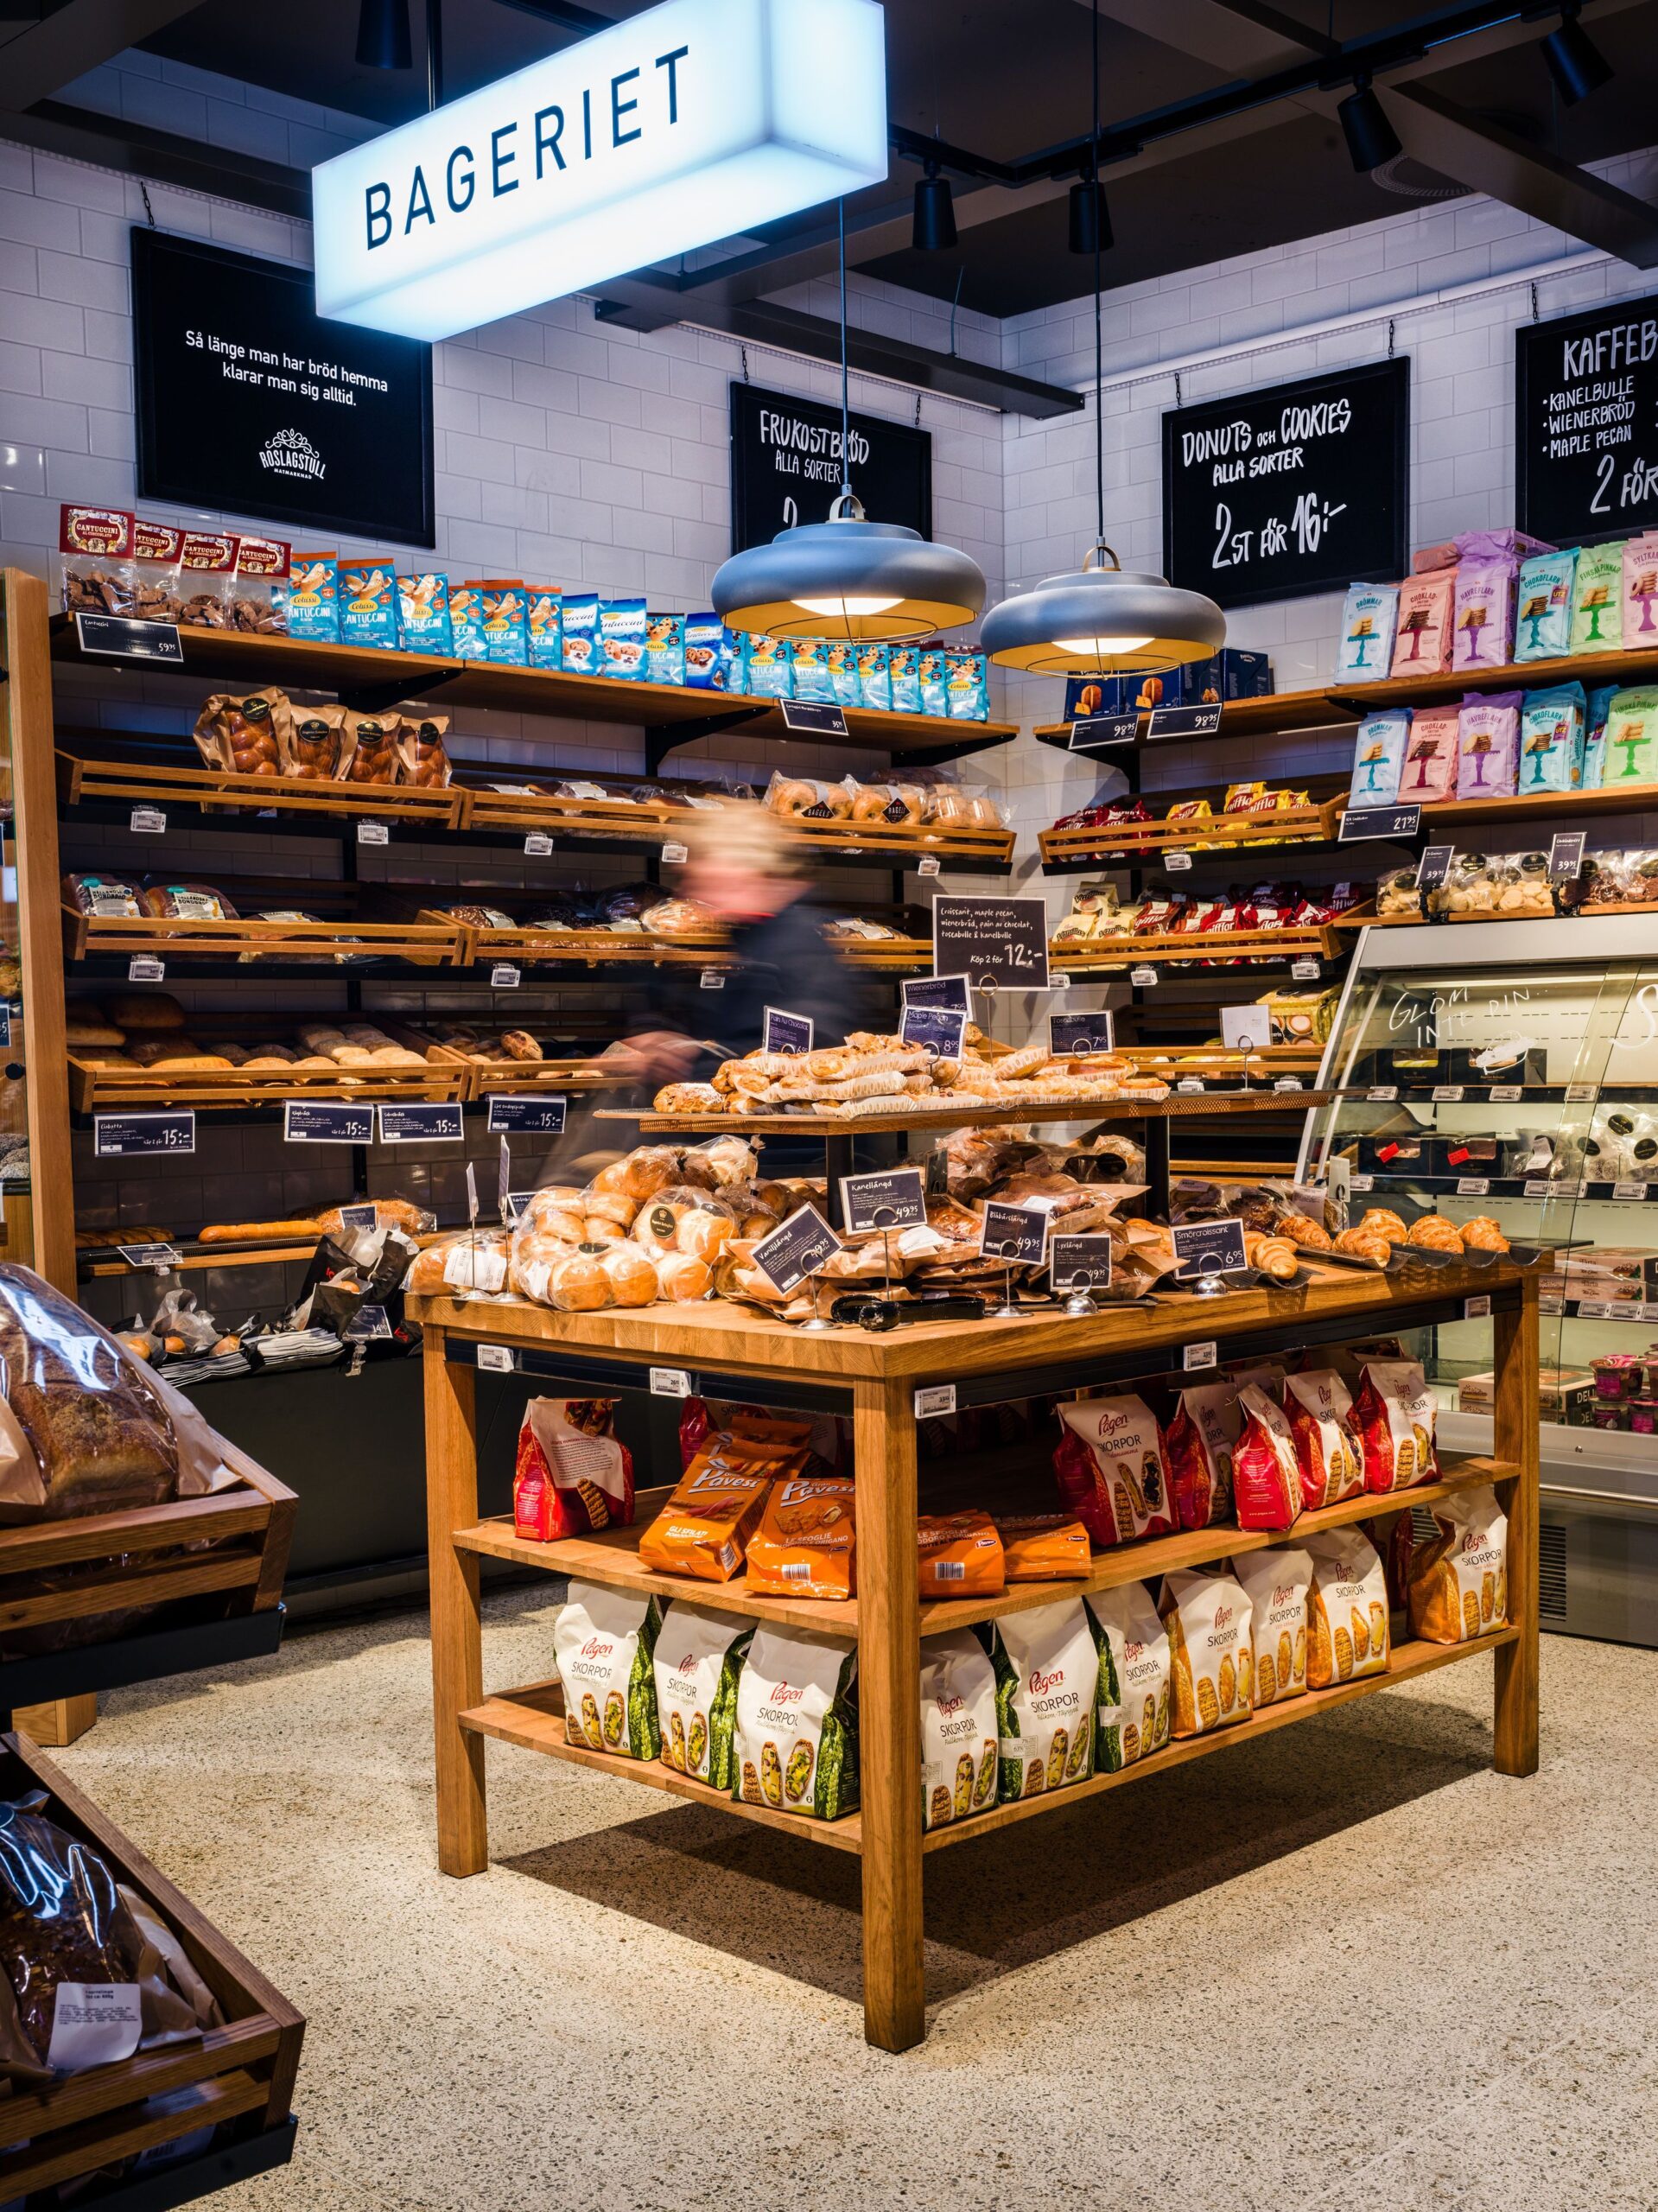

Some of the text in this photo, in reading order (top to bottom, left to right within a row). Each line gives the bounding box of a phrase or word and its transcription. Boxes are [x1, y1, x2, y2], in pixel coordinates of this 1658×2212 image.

[365, 44, 689, 251] BAGERIET
[186, 330, 388, 392] Så länge man har bröd hemma
[223, 361, 357, 407] klarar man sig alltid.
[1550, 376, 1634, 411] KANELBULLE
[1549, 396, 1635, 434] WIENERBRÖD
[1183, 398, 1351, 467] DONUTS OCH COOKIES
[1550, 424, 1631, 459] MAPLE PECAN
[259, 450, 326, 480] ROSLAGSTULL
[274, 467, 312, 480] MATMARKNAD
[776, 449, 841, 484] ALLA SORTER
[1213, 448, 1304, 486] ALLA SORTER
[1591, 454, 1658, 513] 2 FÖR
[77, 524, 118, 534] CANTUCCINI
[1261, 518, 1286, 557] FÖR
[185, 545, 223, 555] CANTUCCINI
[1524, 573, 1560, 588] CHOKOFLARN
[808, 809, 829, 818] BAGELS
[941, 907, 1016, 918] Croissant, maple pecan,
[1135, 915, 1167, 928] gifflar
[980, 920, 994, 929] pain
[1004, 921, 1032, 930] chocolat,
[970, 955, 984, 965] Köp
[992, 955, 1003, 963] för
[907, 982, 945, 991] Wienerbröd
[1389, 987, 1468, 1031] GLÖM
[788, 1019, 809, 1031] Chocolat
[1418, 1011, 1474, 1048] INTE
[852, 1179, 892, 1191] Kanellängd
[1177, 1226, 1229, 1240] Smörcroissant
[1098, 1414, 1128, 1436] Pågen
[1096, 1434, 1141, 1452] SKORPOR
[692, 1469, 761, 1488] Pavesi
[1461, 1548, 1502, 1567] SKORPOR
[1335, 1562, 1354, 1583] Pågen
[1273, 1585, 1294, 1608] Pågen
[1336, 1584, 1366, 1599] SKORPOR
[1215, 1606, 1234, 1630] Pågen
[1268, 1605, 1301, 1626] SKORPOR
[581, 1637, 613, 1659] Pågen
[1207, 1628, 1239, 1648] SKORPOR
[1123, 1640, 1143, 1662] Pågen
[1125, 1660, 1161, 1681] SKORPOR
[1029, 1669, 1064, 1696] Pågen
[770, 1681, 804, 1706] Pågen
[1031, 1692, 1080, 1713] SKORPOR
[937, 1694, 964, 1719] Pågen
[940, 1719, 977, 1738] SKORPOR
